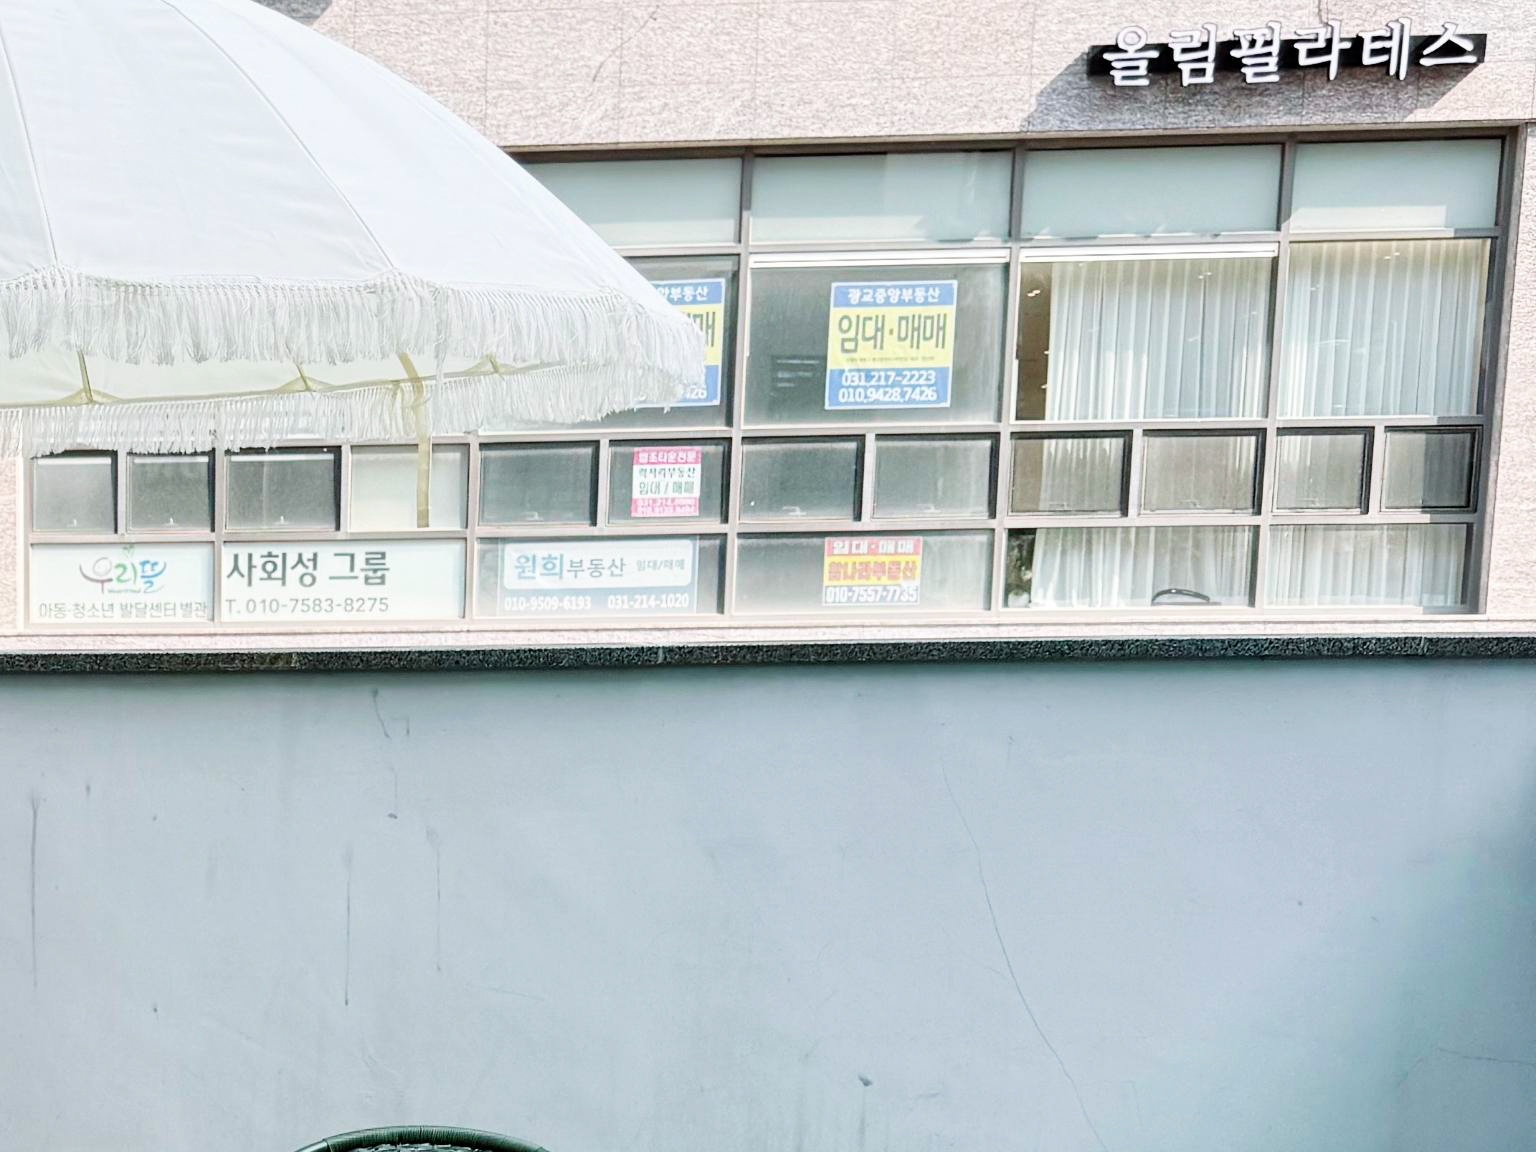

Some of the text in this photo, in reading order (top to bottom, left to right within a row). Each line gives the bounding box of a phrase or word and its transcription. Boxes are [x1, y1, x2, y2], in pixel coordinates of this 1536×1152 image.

[1103, 17, 1478, 87] 올림필라테스
[226, 551, 390, 588] 사회성 그룹
[245, 597, 389, 614] 010-7583-8275
